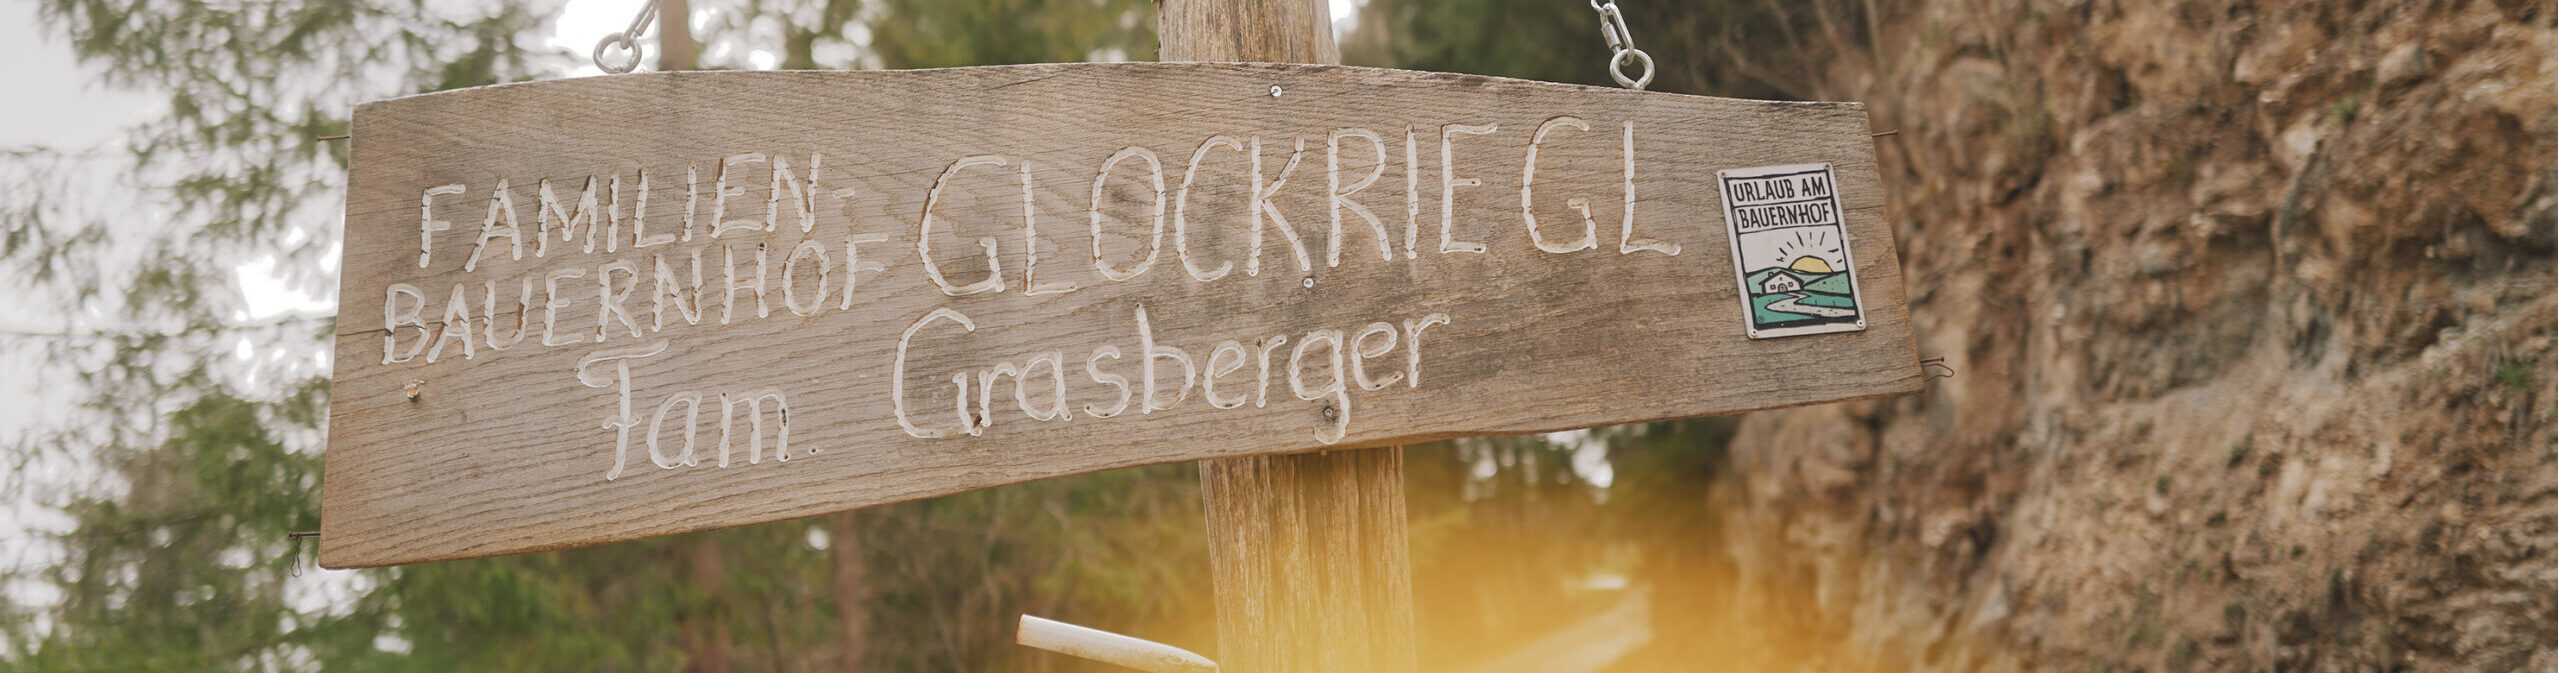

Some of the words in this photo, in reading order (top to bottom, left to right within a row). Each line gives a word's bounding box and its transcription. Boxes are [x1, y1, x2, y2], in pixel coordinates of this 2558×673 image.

[418, 152, 856, 272] FAMILIEN-
[918, 114, 1682, 296] GLOCKRIEGL
[1733, 178, 1795, 202] URLAUB
[1801, 176, 1826, 197] AM
[1737, 202, 1830, 230] BAUERNHOF
[382, 232, 889, 365] BAUERNHOF
[575, 339, 822, 481] Fam.
[892, 303, 1451, 446] Grasberger
